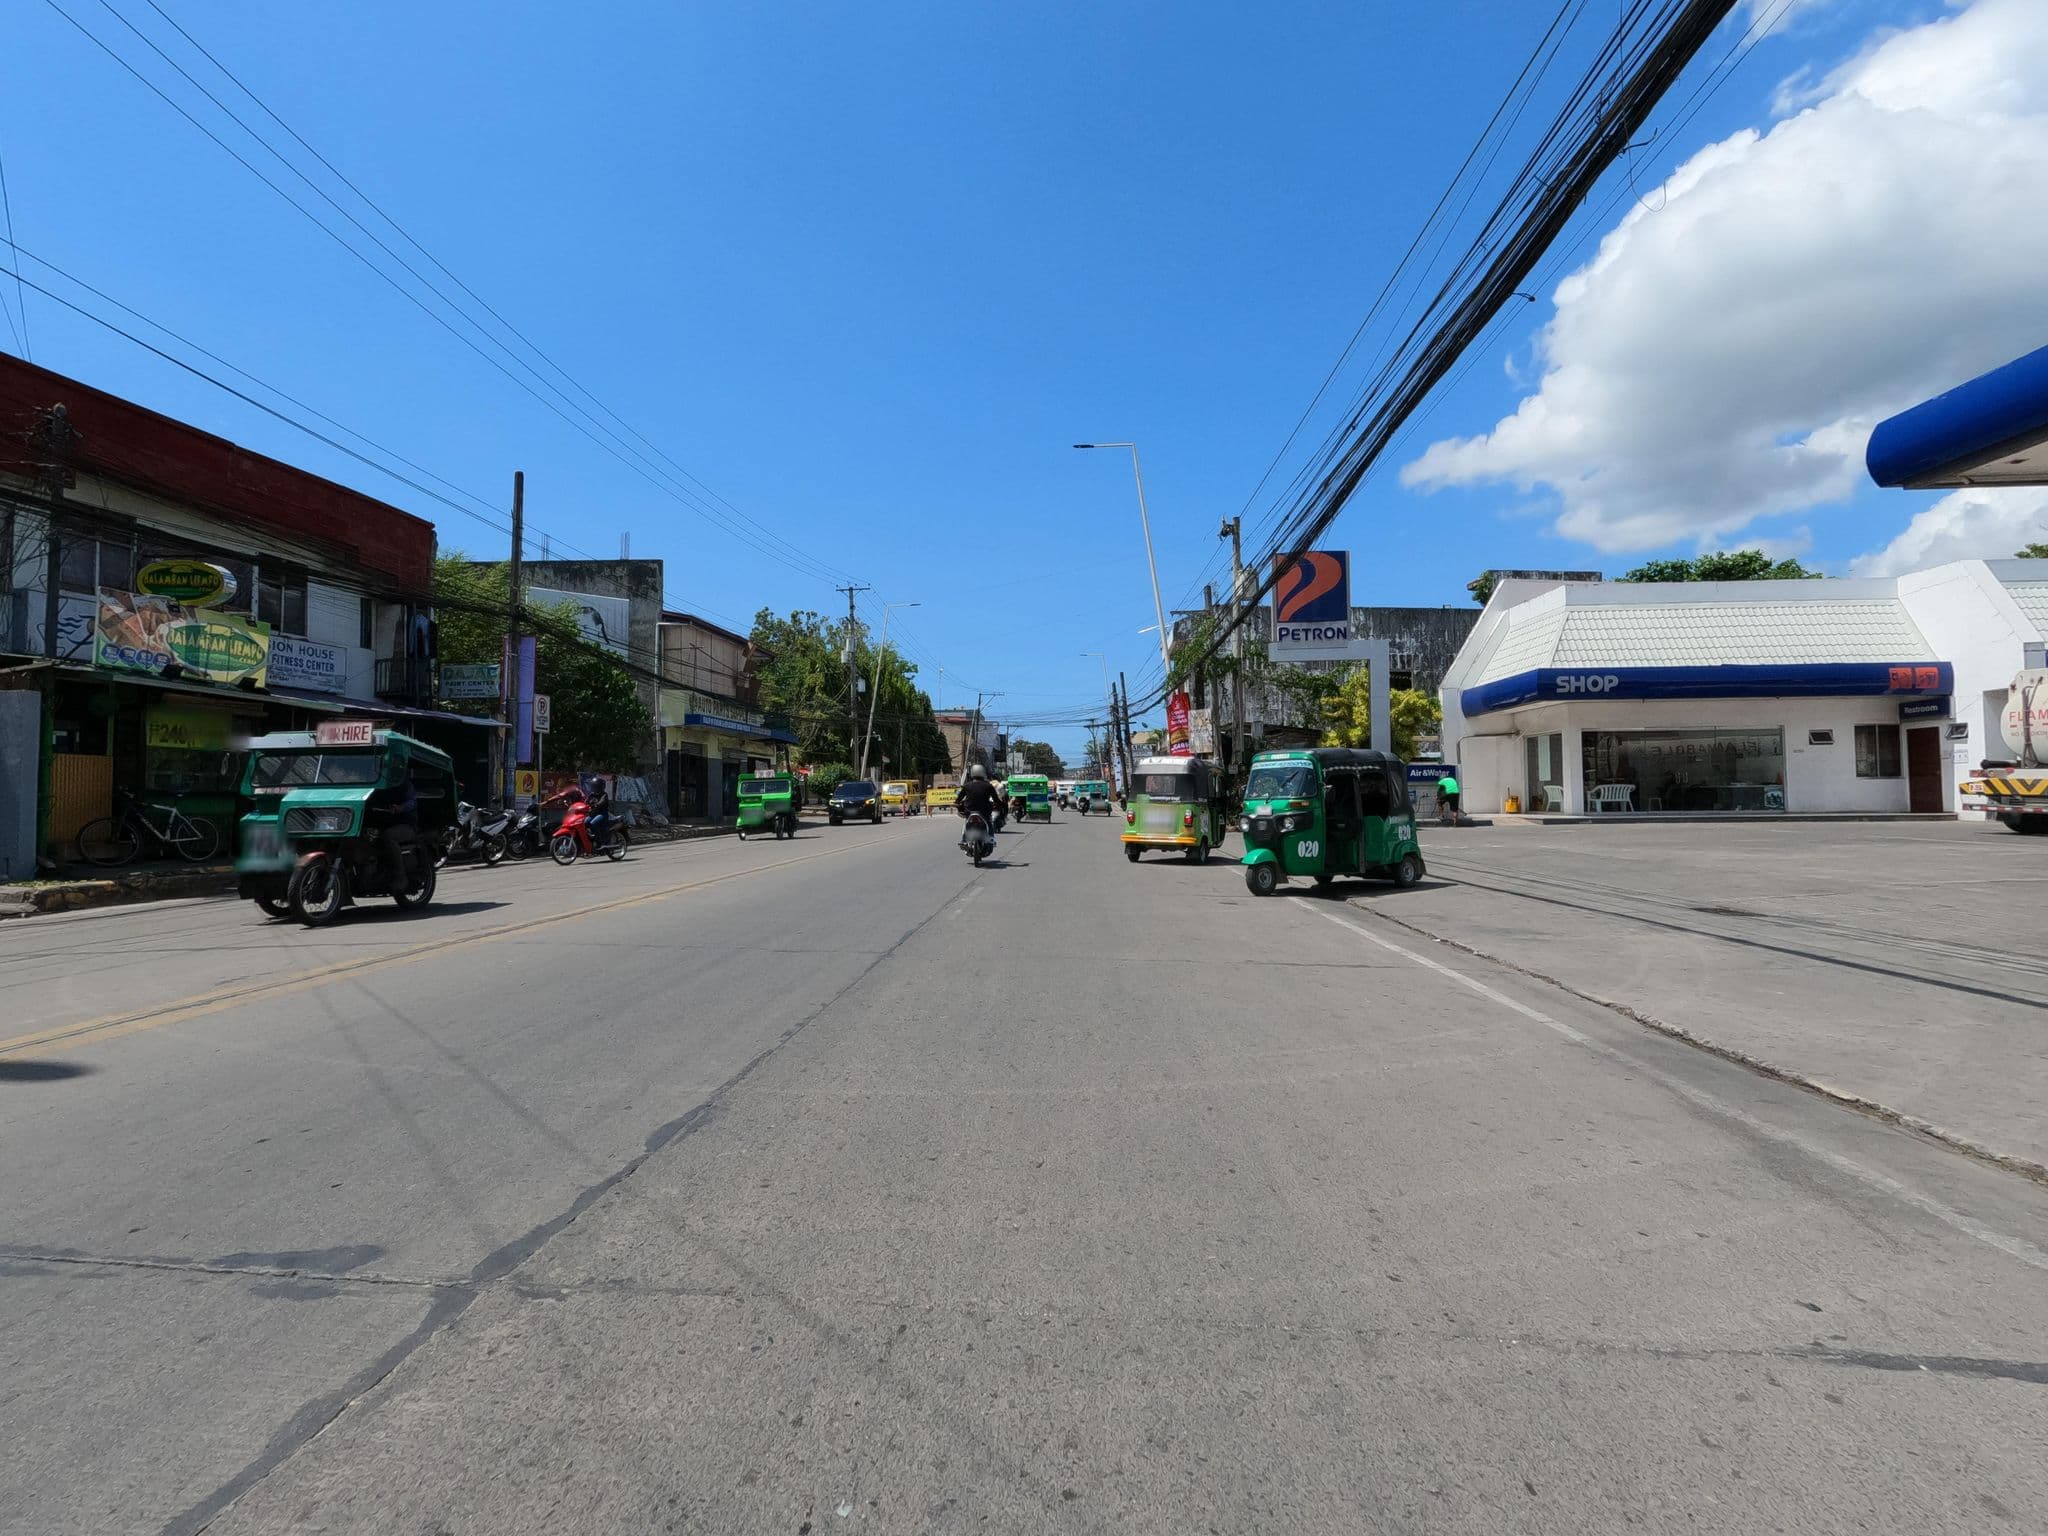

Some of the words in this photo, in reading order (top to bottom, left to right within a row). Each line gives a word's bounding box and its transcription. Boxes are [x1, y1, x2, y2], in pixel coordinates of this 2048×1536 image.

[1278, 627, 1347, 641] PETRON
[299, 645, 335, 660] HOUSE
[271, 654, 304, 668] FITNESS
[306, 660, 335, 672] CENTER
[1556, 675, 1619, 693] SHOP
[1904, 704, 1938, 714] Restroom
[342, 725, 369, 741] HIRE
[1298, 840, 1320, 857] 020
